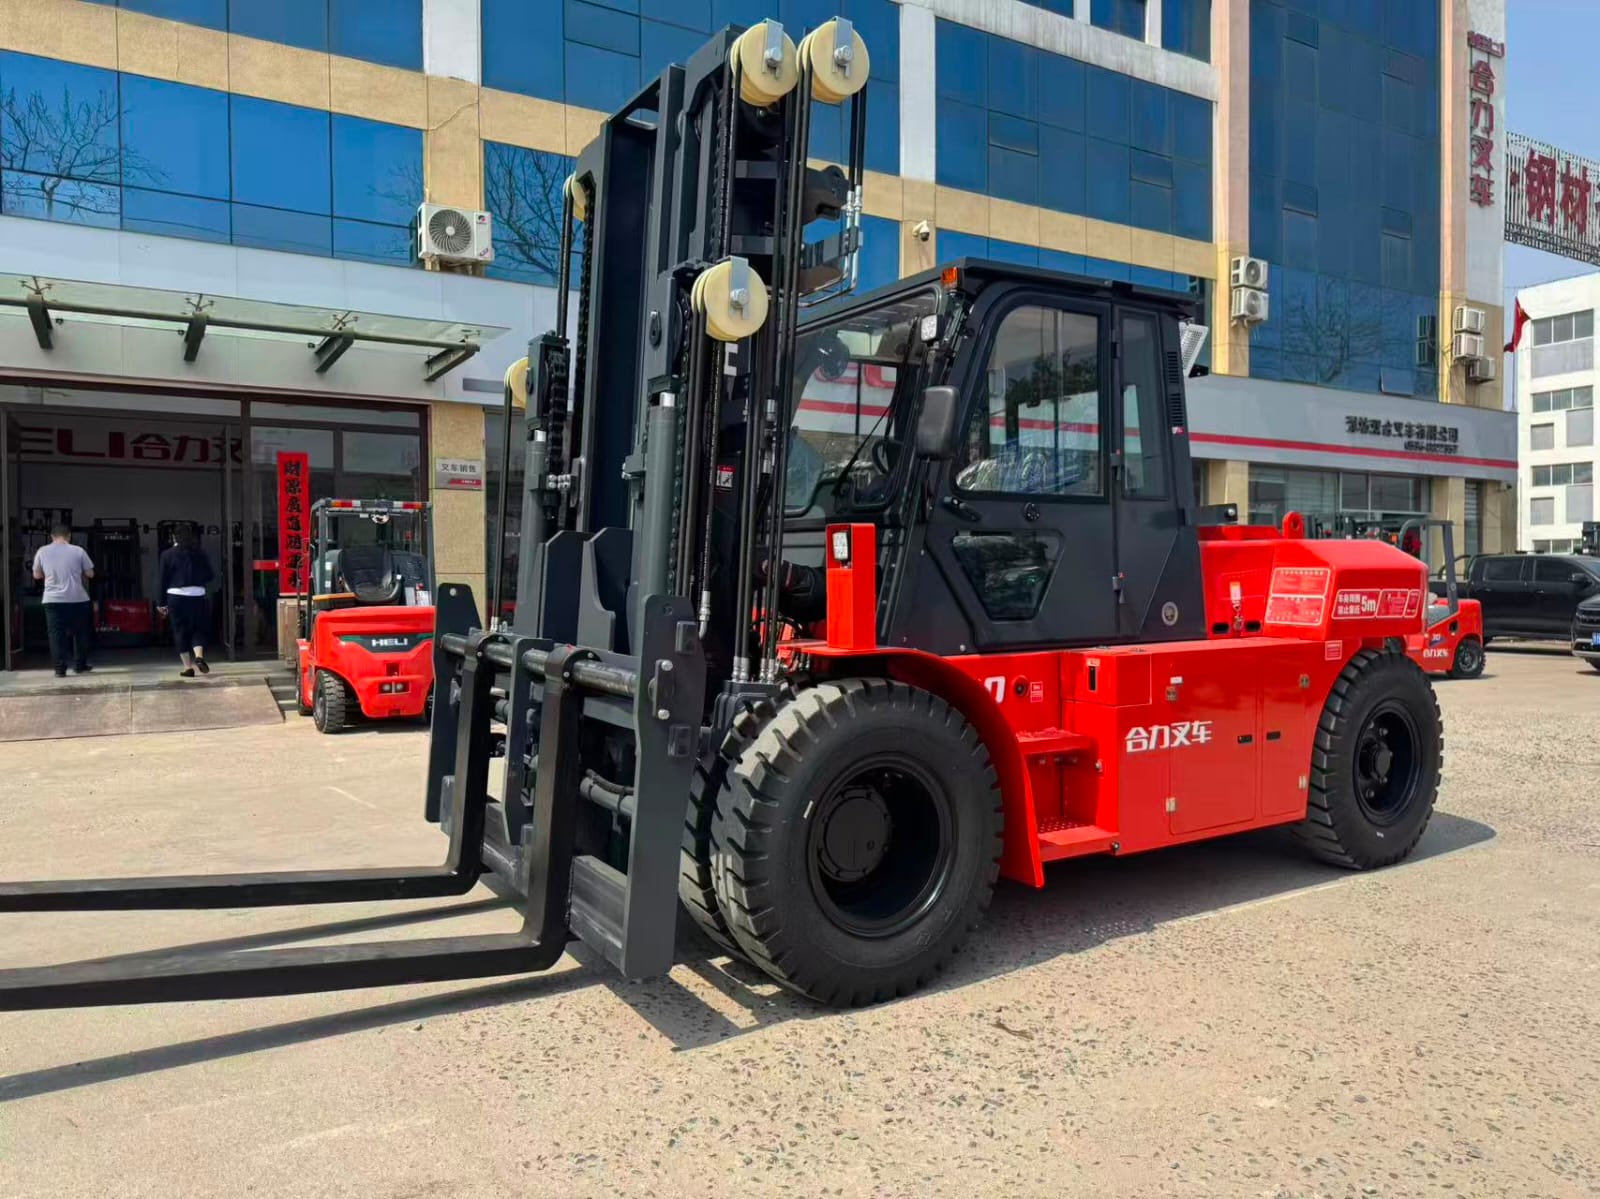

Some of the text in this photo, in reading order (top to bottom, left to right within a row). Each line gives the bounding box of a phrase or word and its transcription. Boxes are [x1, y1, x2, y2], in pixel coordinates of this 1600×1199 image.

[1470, 60, 1495, 208] 合力叉车
[1524, 147, 1600, 236] 钢材
[1361, 595, 1376, 612] 5m
[371, 637, 408, 647] HELI
[1124, 720, 1213, 753] 合力叉车
